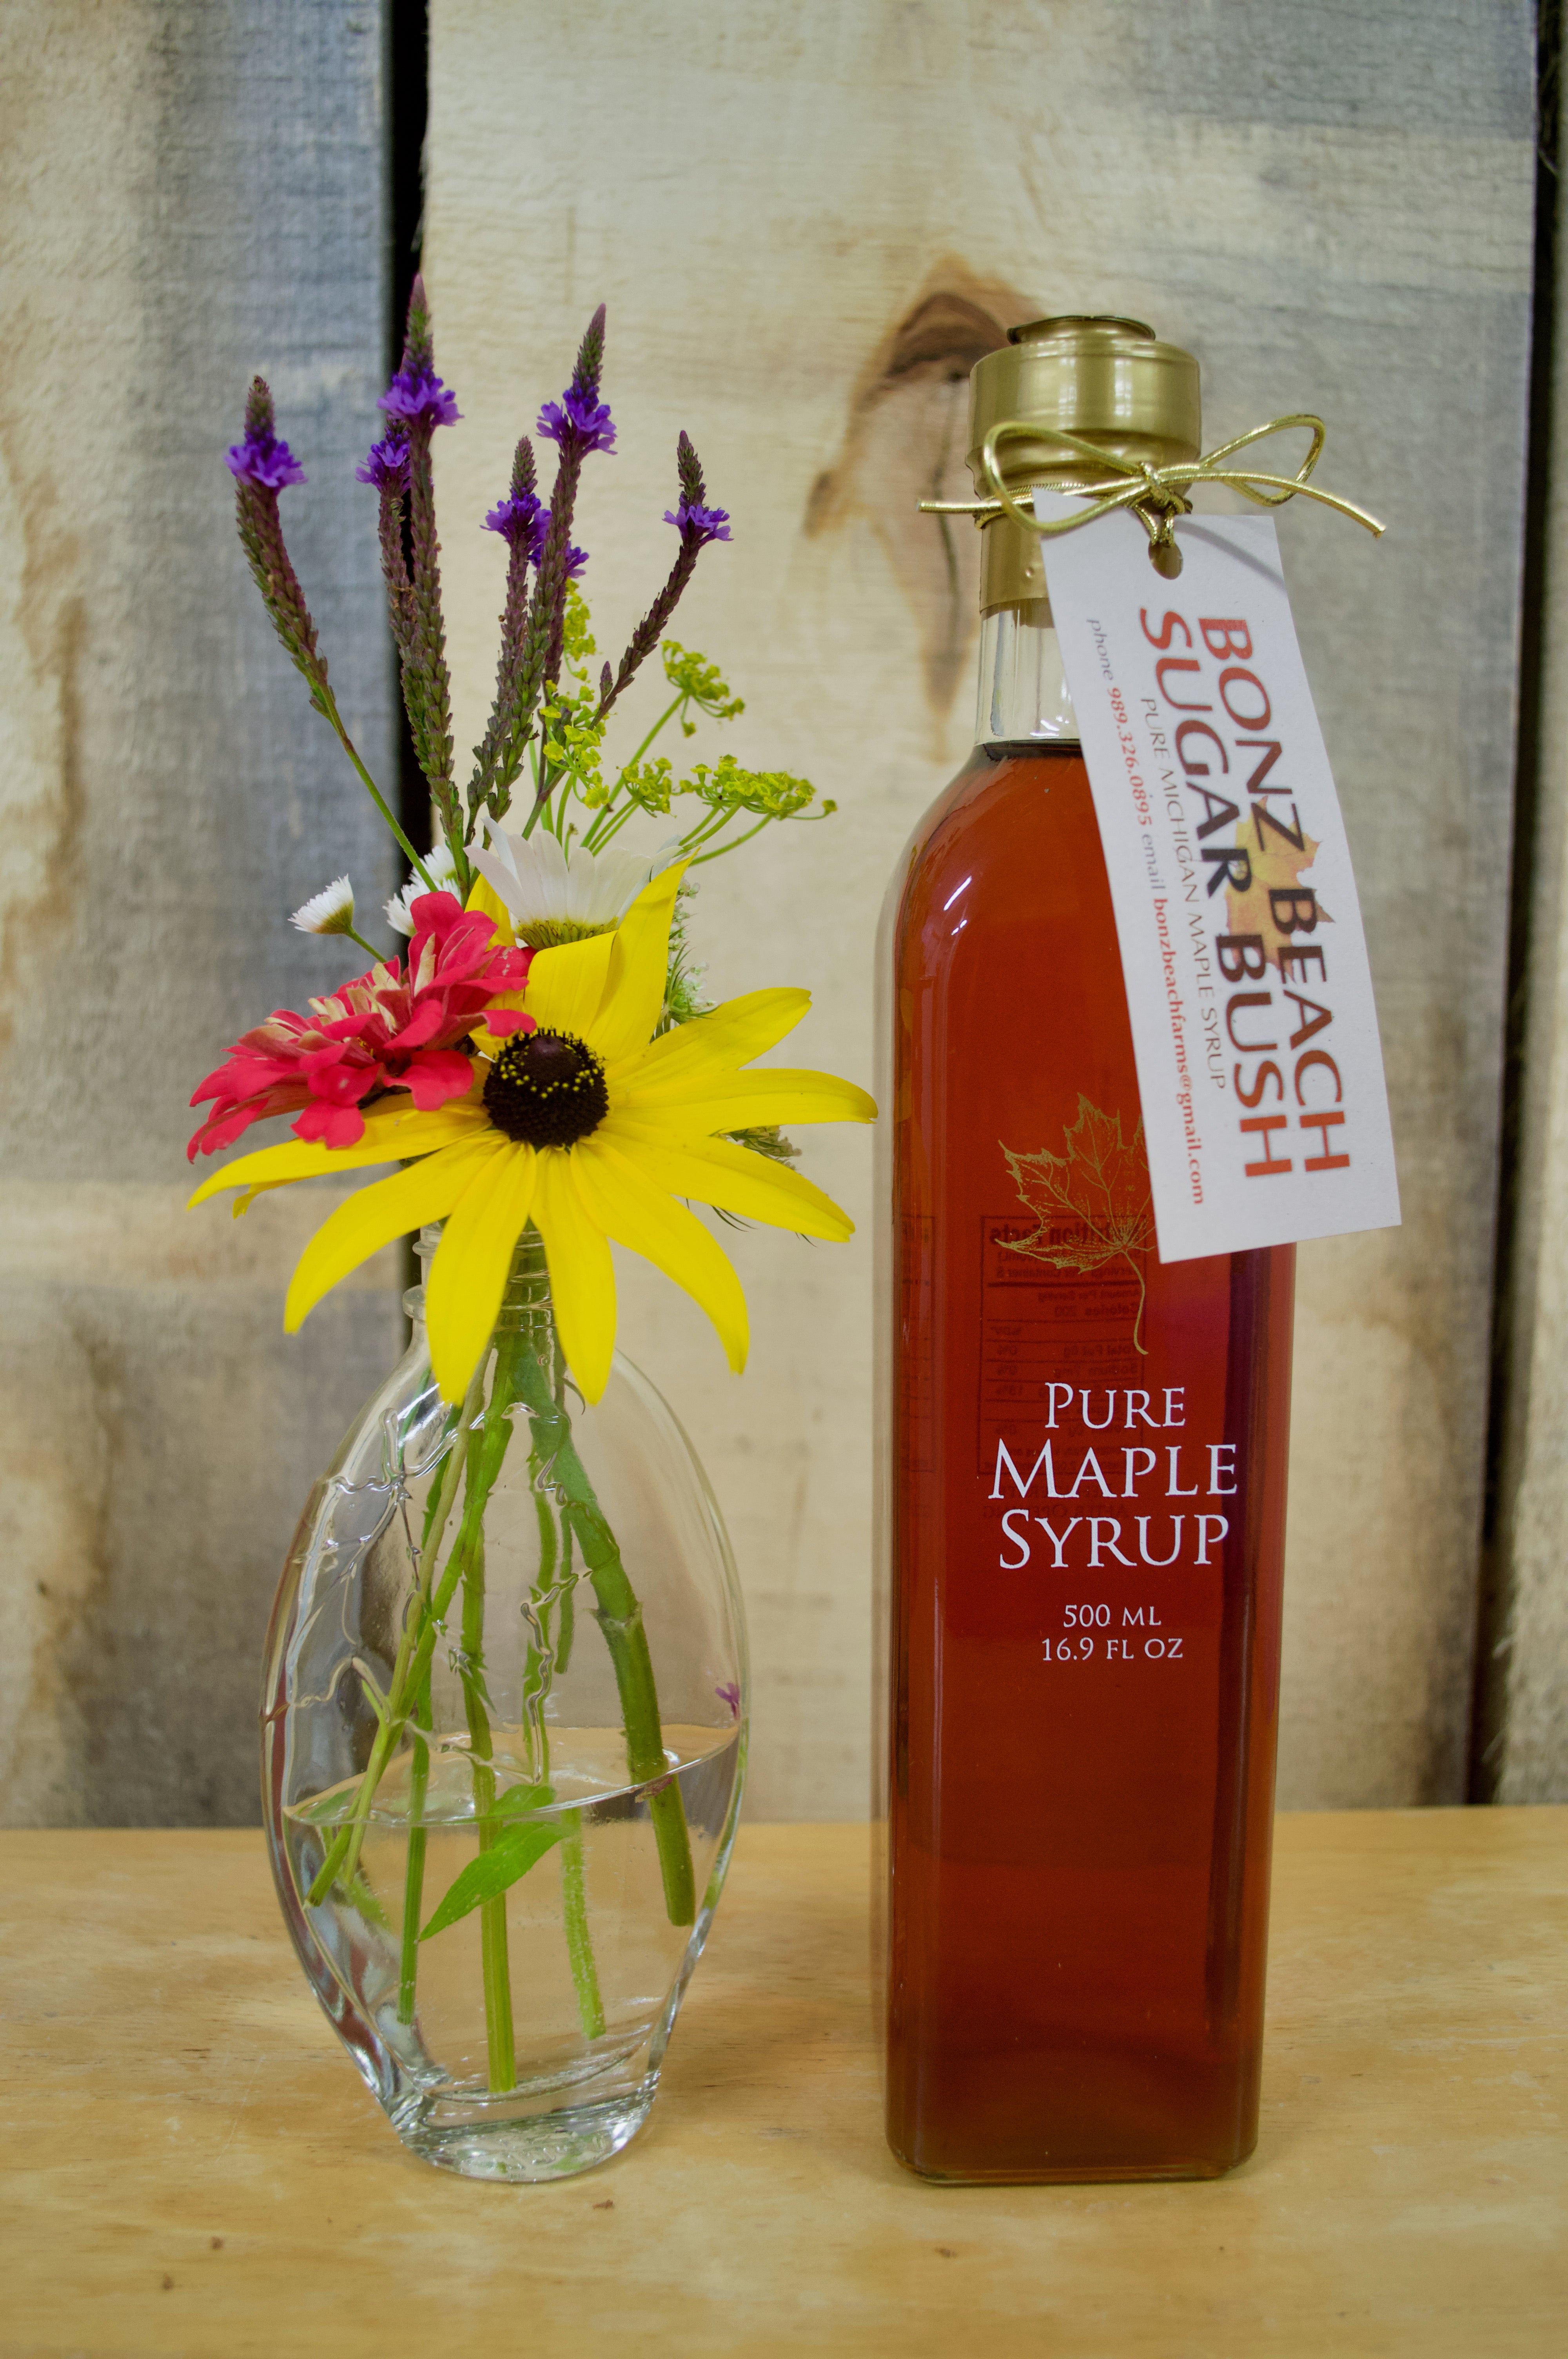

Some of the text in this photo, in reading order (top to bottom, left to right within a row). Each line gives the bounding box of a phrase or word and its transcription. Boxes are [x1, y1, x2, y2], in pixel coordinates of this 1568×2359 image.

[1087, 620, 1203, 1205] phone 989.326.0895 email bonzbeachfarms@gmail.com
[1140, 607, 1292, 1177] SUGAR BUSH
[1140, 698, 1226, 1090] PURE MICHIGAN MAPLE SYRUP
[1199, 619, 1350, 1172] BONZ BEACH
[1044, 1382, 1186, 1429] PURE
[987, 1438, 1238, 1499] MAPLE
[1000, 1508, 1229, 1570] SYRUP
[1063, 1603, 1162, 1628] 500 ML
[1042, 1637, 1183, 1661] 16.9 FL OZ
